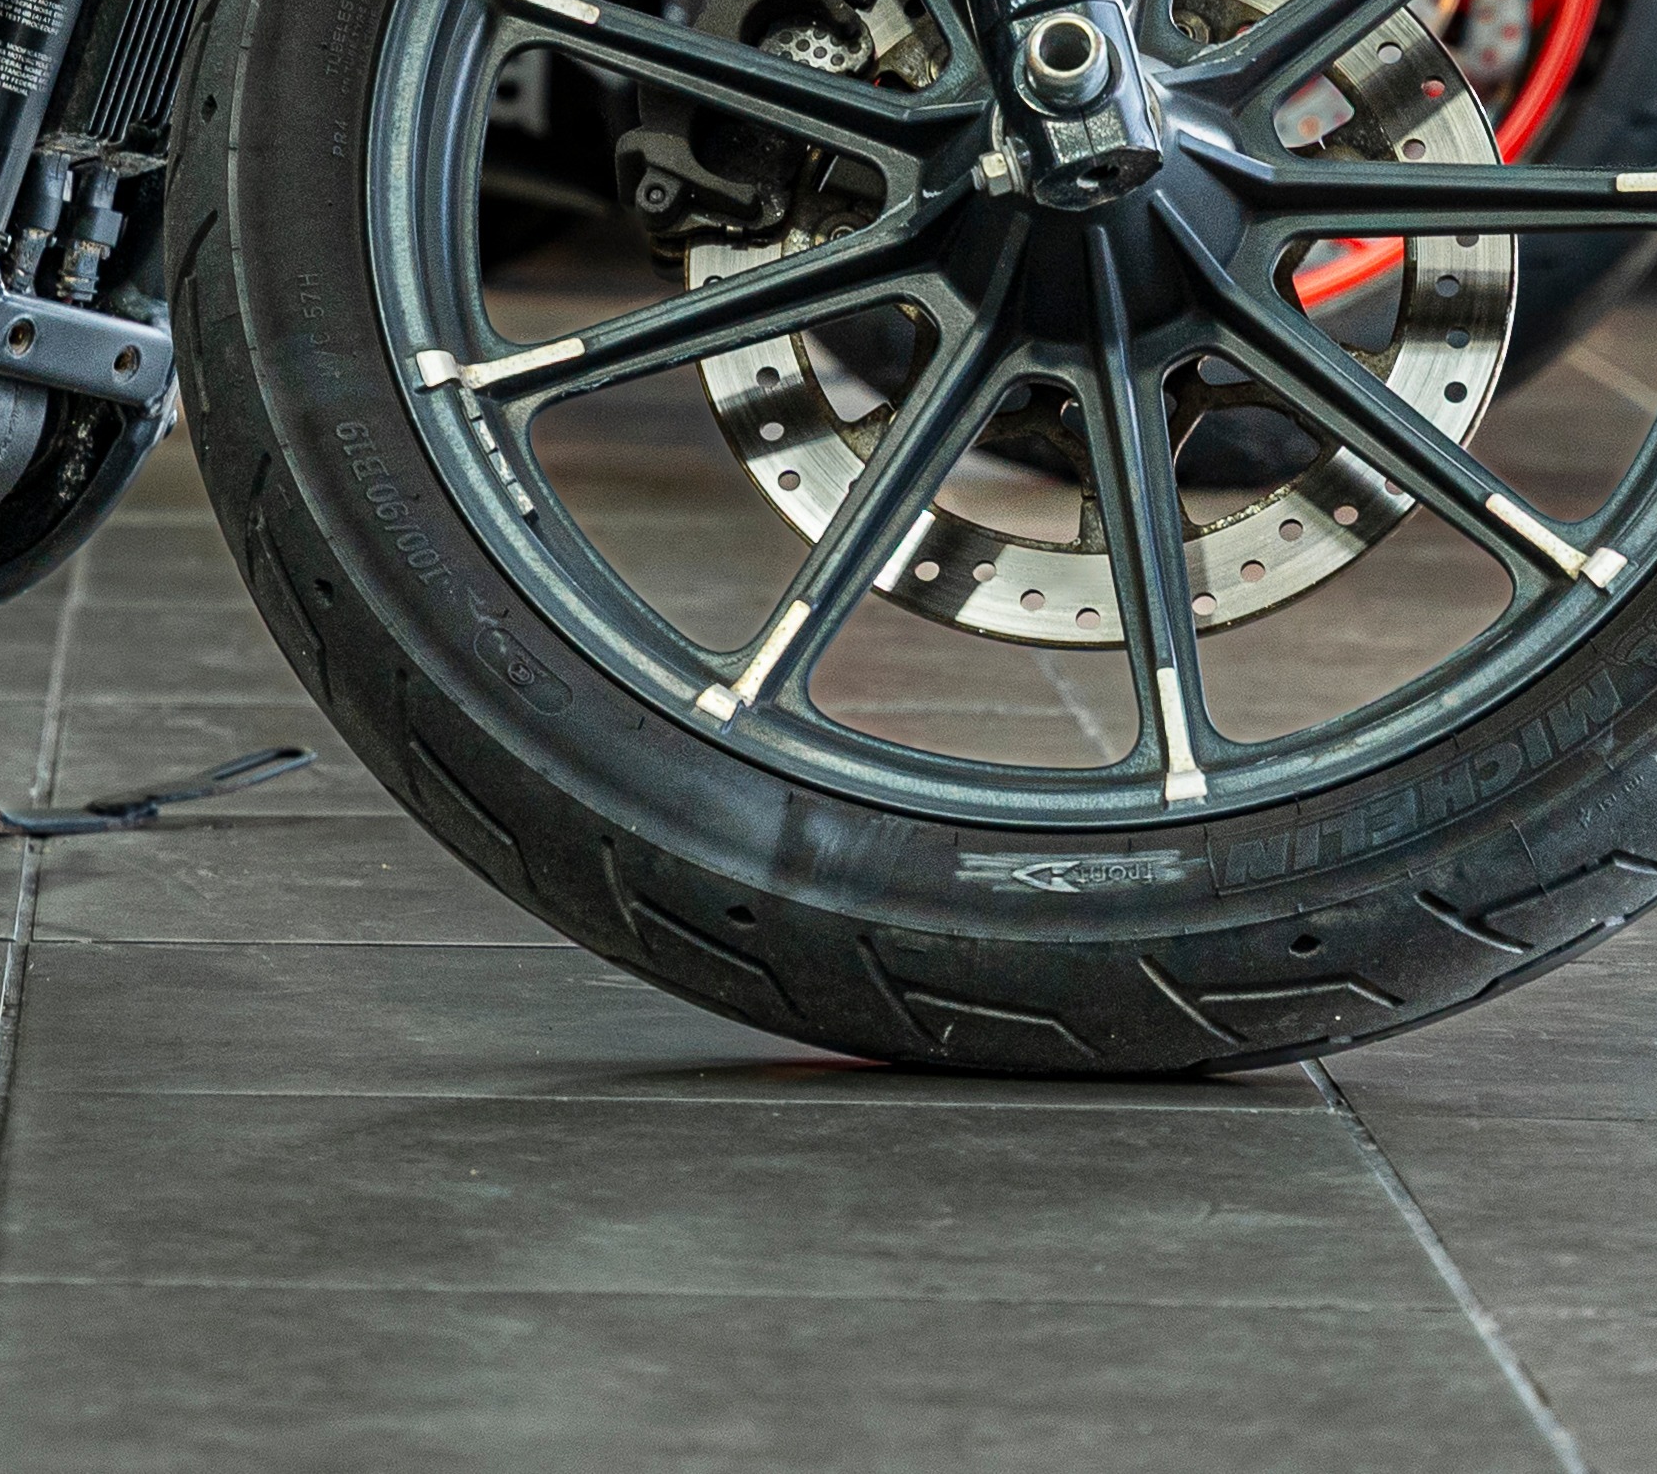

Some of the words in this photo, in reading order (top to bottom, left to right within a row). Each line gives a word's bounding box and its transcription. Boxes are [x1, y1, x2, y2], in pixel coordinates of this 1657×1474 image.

[293, 271, 327, 319] 57H
[335, 421, 453, 585] 100/90B19
[1224, 669, 1622, 886] MICHELIN
